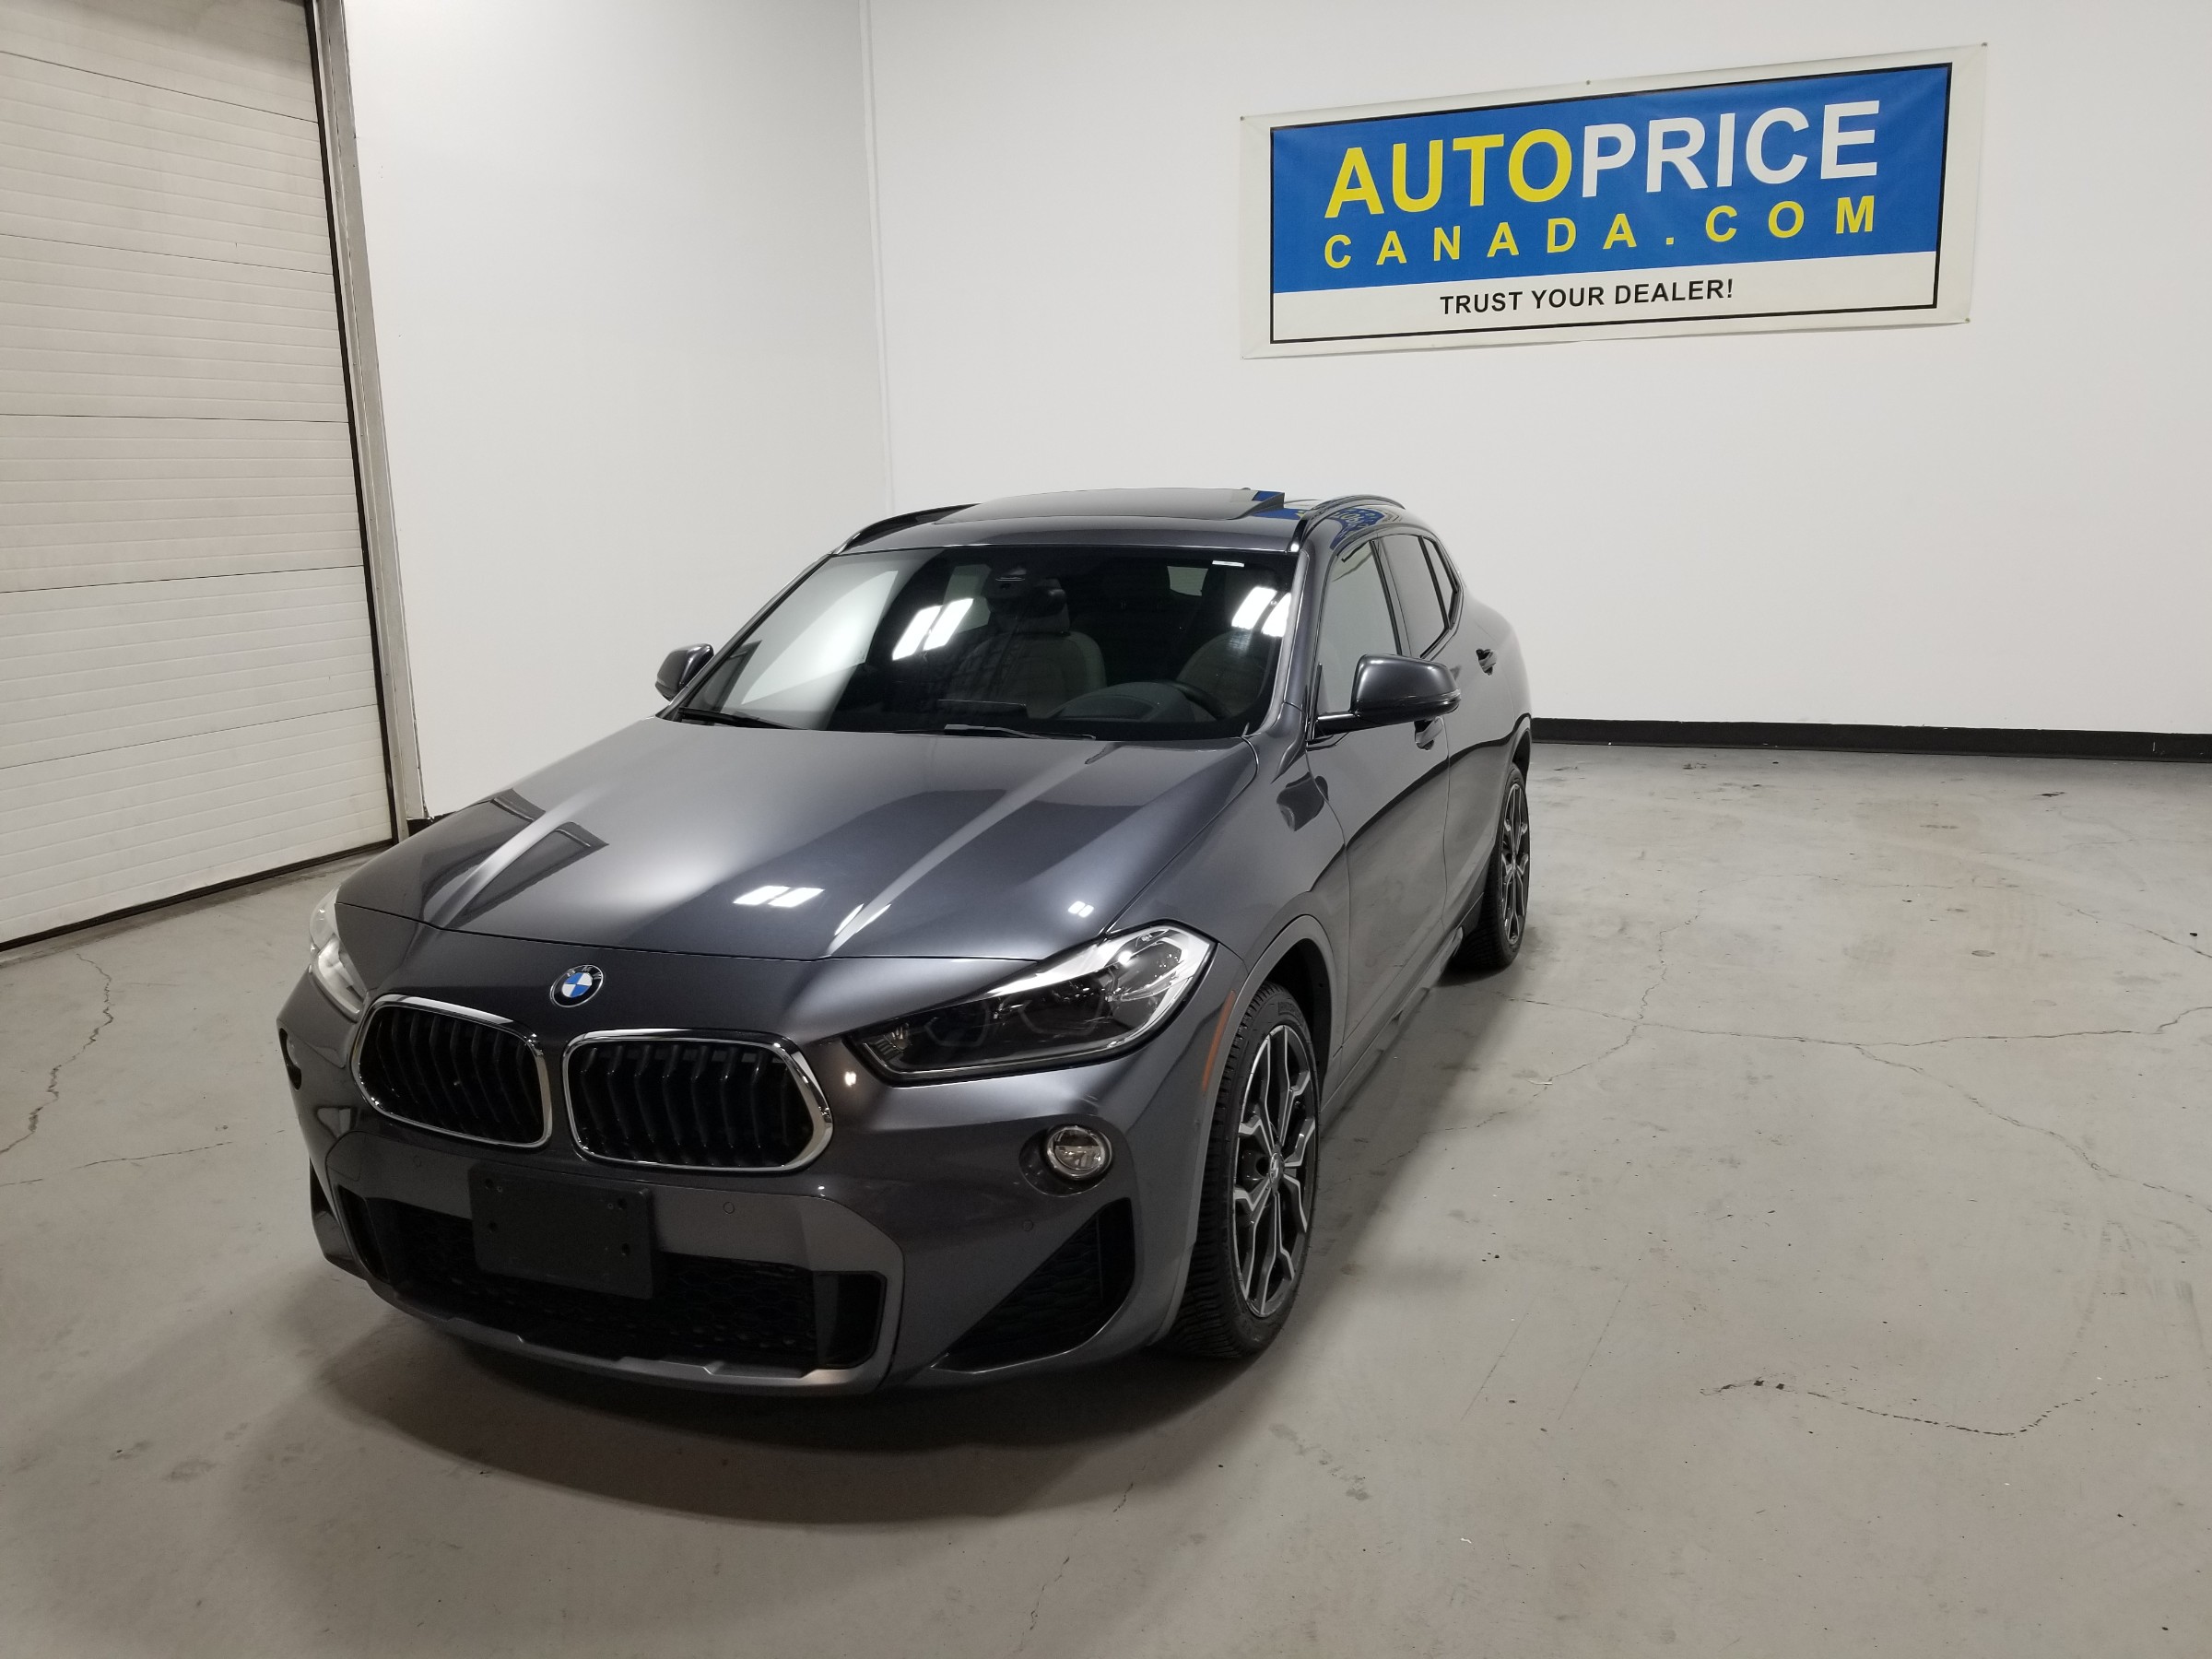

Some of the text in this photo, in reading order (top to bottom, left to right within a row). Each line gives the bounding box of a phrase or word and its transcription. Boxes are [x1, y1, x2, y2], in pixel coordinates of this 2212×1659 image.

[1324, 100, 1881, 218] AUTOPRICE
[1440, 278, 1735, 315] TRUST YOUR DEALER!
